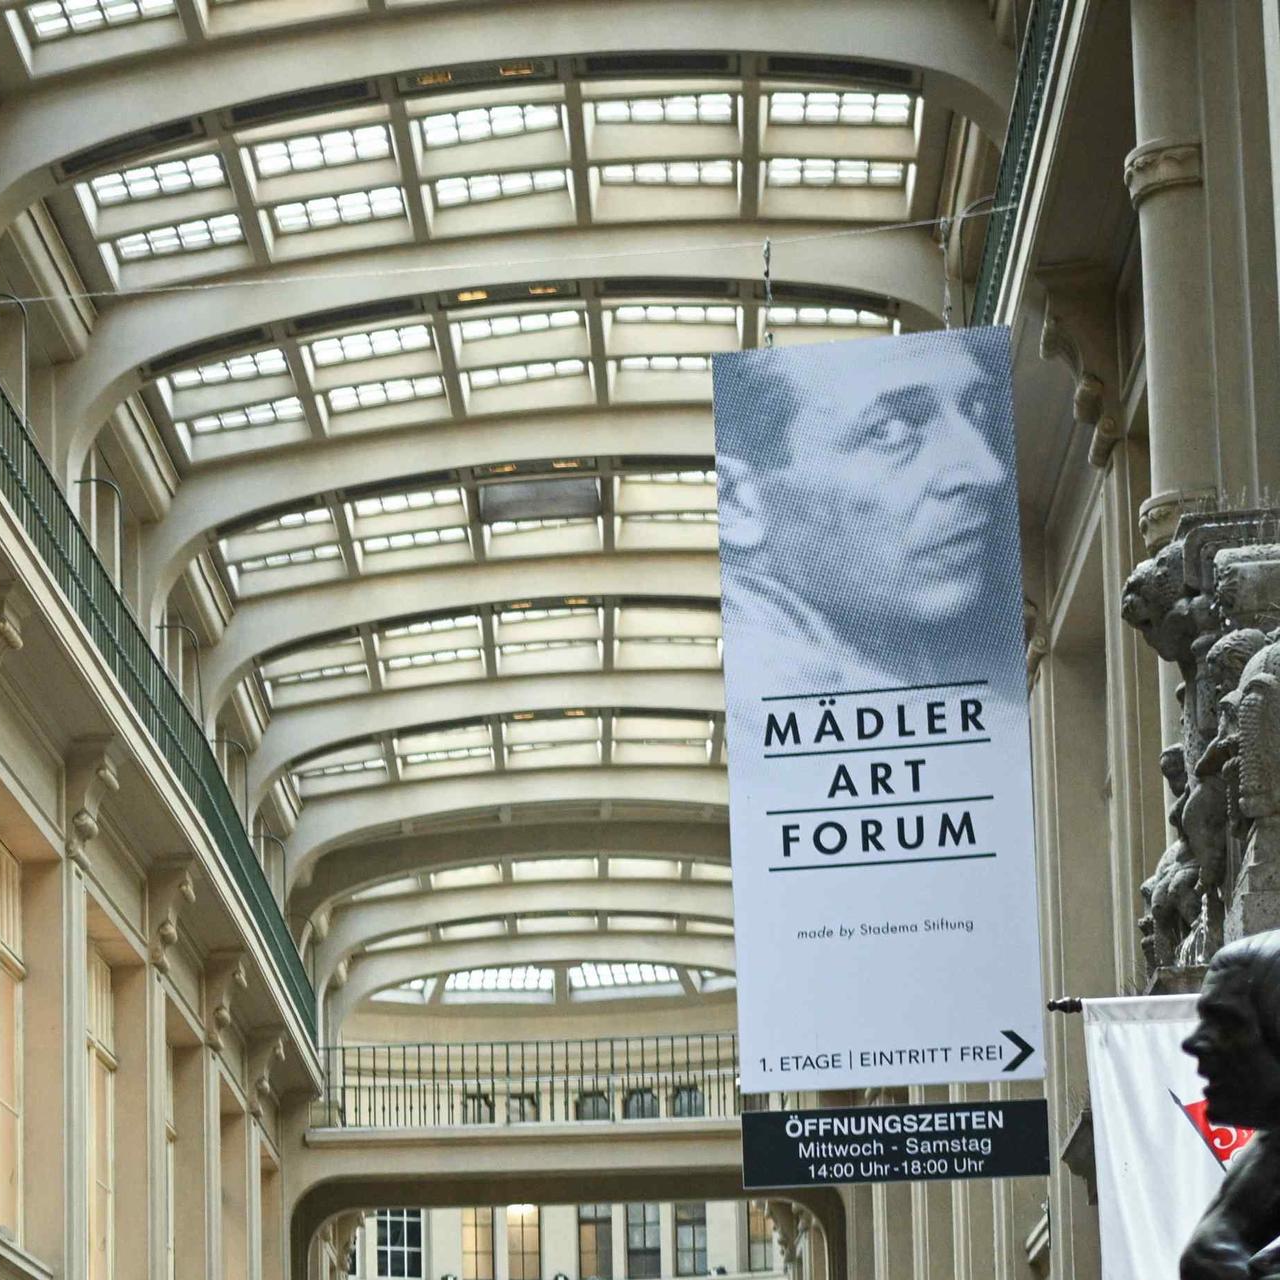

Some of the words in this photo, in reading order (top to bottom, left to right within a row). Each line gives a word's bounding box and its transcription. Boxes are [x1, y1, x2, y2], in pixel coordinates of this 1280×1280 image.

[764, 699, 987, 747] MÄDLER
[827, 759, 927, 799] ART
[781, 812, 977, 858] FORUM
[796, 927, 834, 940] made
[839, 924, 855, 940] by
[860, 920, 919, 936] Stadema
[923, 916, 975, 935] Stiftung
[759, 1057, 774, 1073] 1.
[779, 1053, 842, 1072] ETAGE
[859, 1046, 952, 1068] EINTRITT
[960, 1045, 1003, 1063] FREI
[784, 1110, 1004, 1138] ÖFFNUNGSZEITEN
[798, 1140, 884, 1158] Mittwoch
[905, 1136, 992, 1156] Samstag
[808, 1163, 855, 1180] 14:00
[860, 1161, 890, 1177] Uhr
[954, 1157, 985, 1173] Uhr
